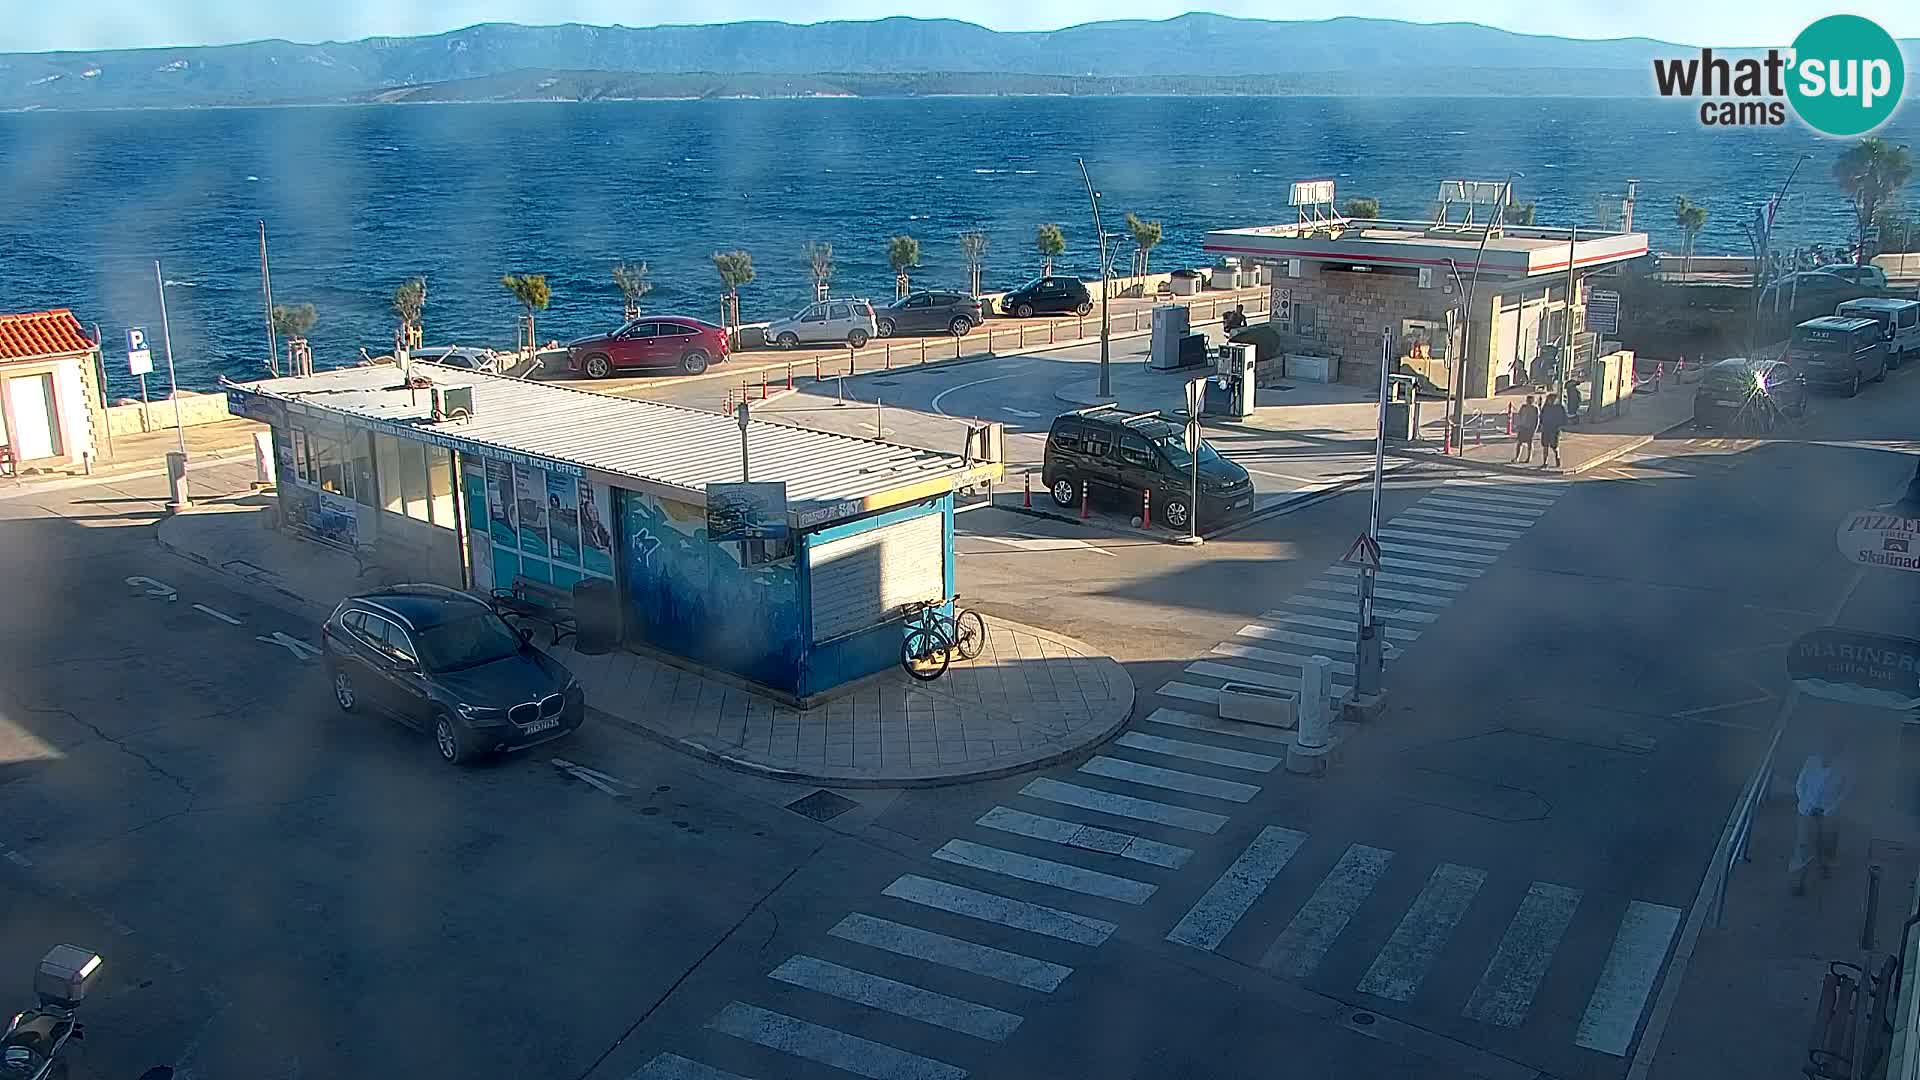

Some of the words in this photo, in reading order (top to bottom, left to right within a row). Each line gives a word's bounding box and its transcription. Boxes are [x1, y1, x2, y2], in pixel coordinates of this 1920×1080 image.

[478, 446, 493, 457] BUS
[494, 450, 527, 465] STATION
[529, 457, 555, 472] TICKET
[555, 463, 583, 477] OFFICE
[1848, 515, 1920, 534] PIZZE
